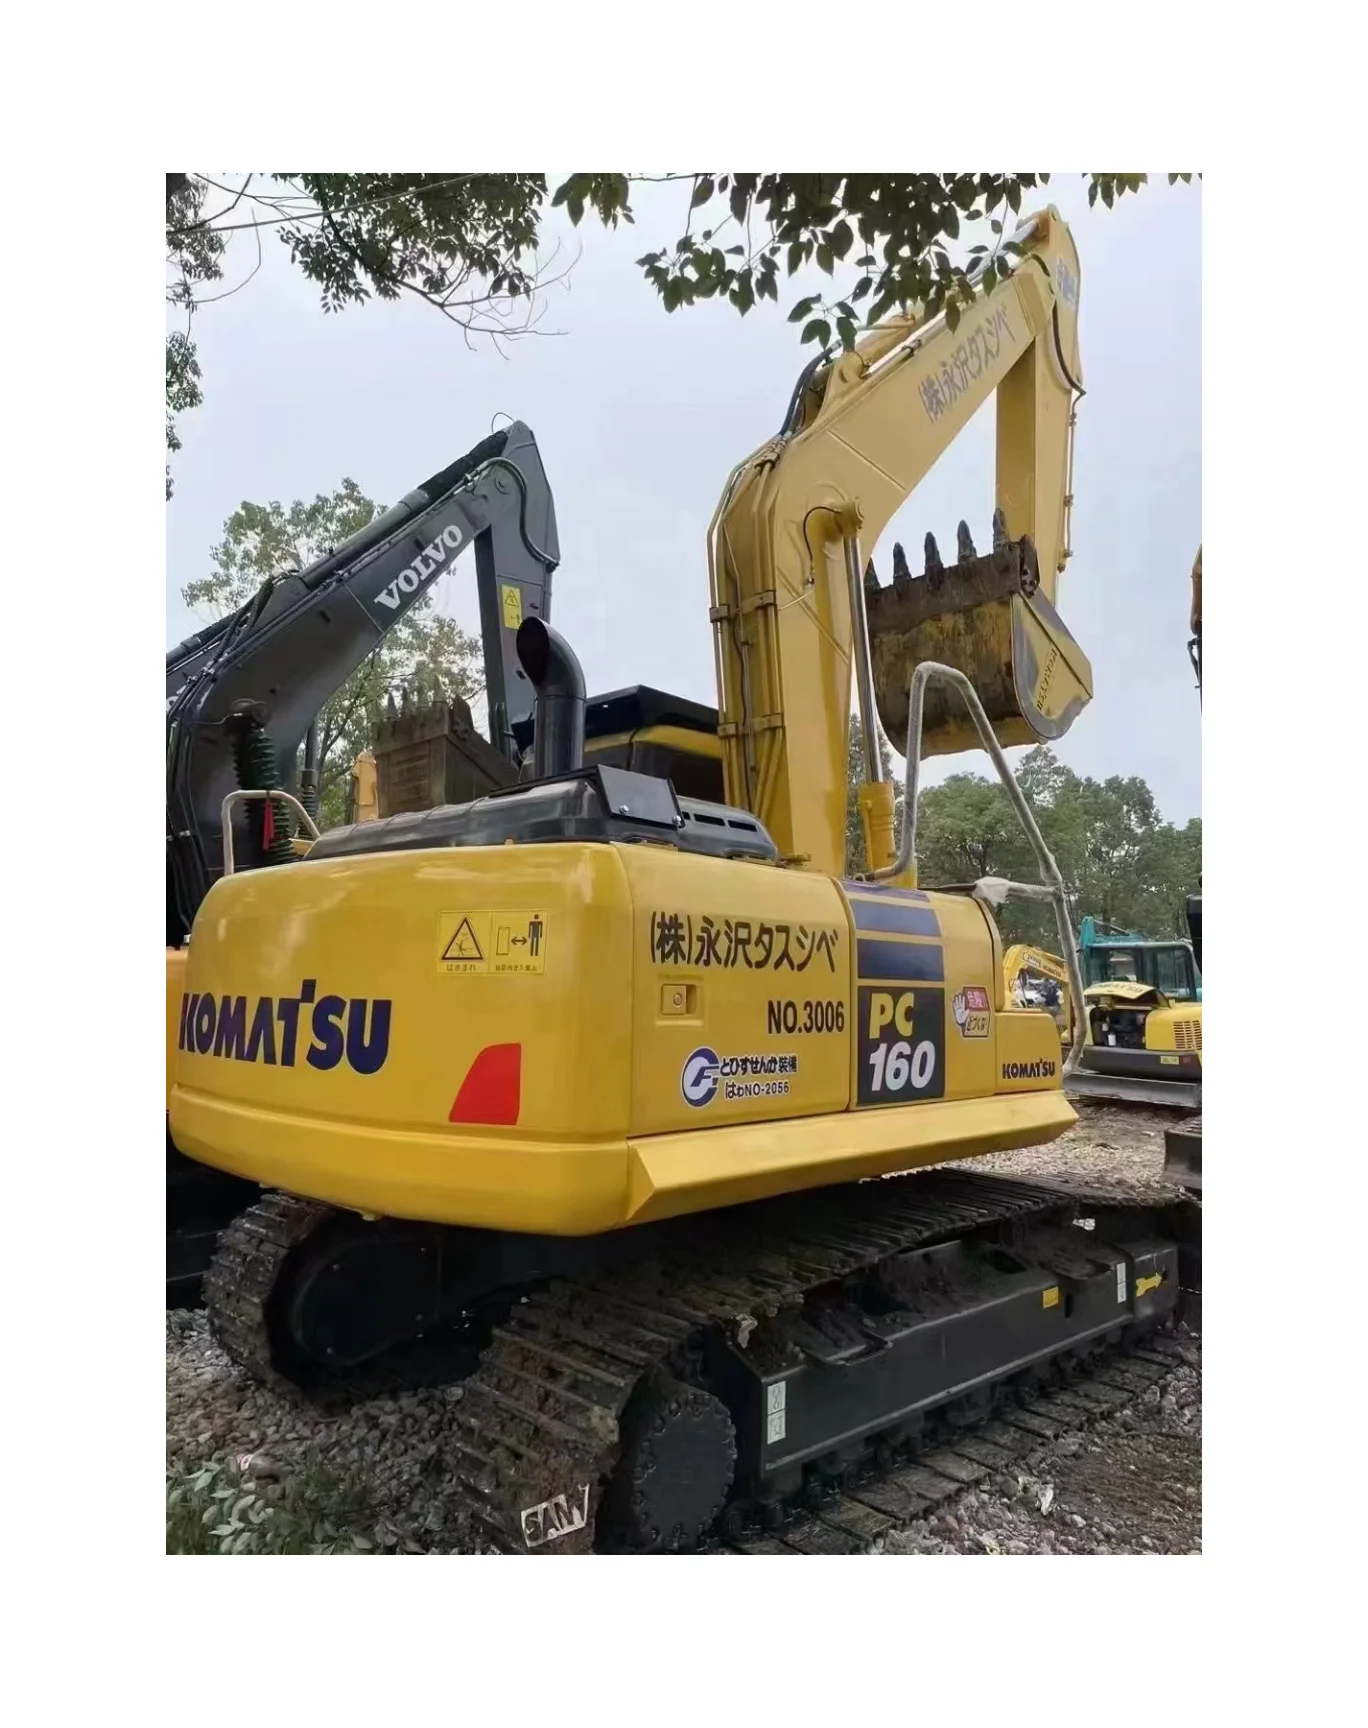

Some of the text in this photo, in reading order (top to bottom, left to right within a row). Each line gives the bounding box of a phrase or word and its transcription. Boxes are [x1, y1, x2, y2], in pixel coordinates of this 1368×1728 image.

[374, 525, 463, 610] VOLVO
[178, 979, 392, 1074] KOMATSU
[767, 1001, 845, 1035] NO.3006
[869, 992, 915, 1039] PC
[869, 1040, 936, 1092] 160
[1002, 1058, 1056, 1080] KOMATSU
